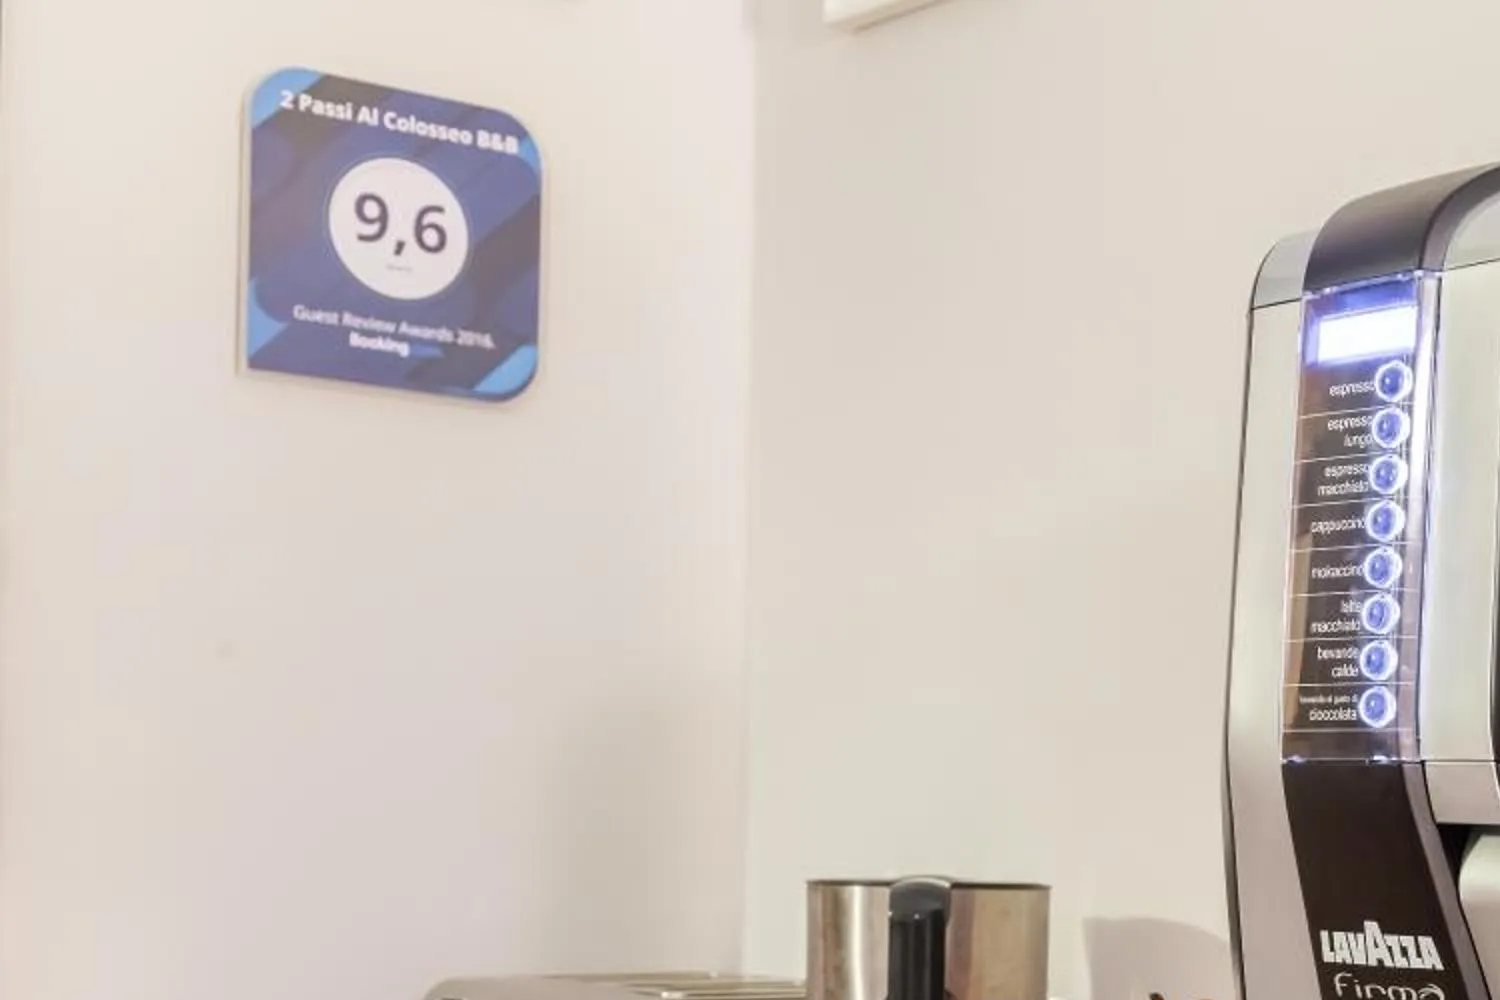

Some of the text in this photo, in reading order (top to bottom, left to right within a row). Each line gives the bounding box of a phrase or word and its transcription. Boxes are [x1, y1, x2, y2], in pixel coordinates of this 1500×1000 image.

[279, 90, 294, 109] 2
[299, 94, 353, 122] Passi
[383, 112, 474, 146] Colosseo
[353, 193, 448, 255] 9,6
[1320, 920, 1445, 971] LAVAZZA
